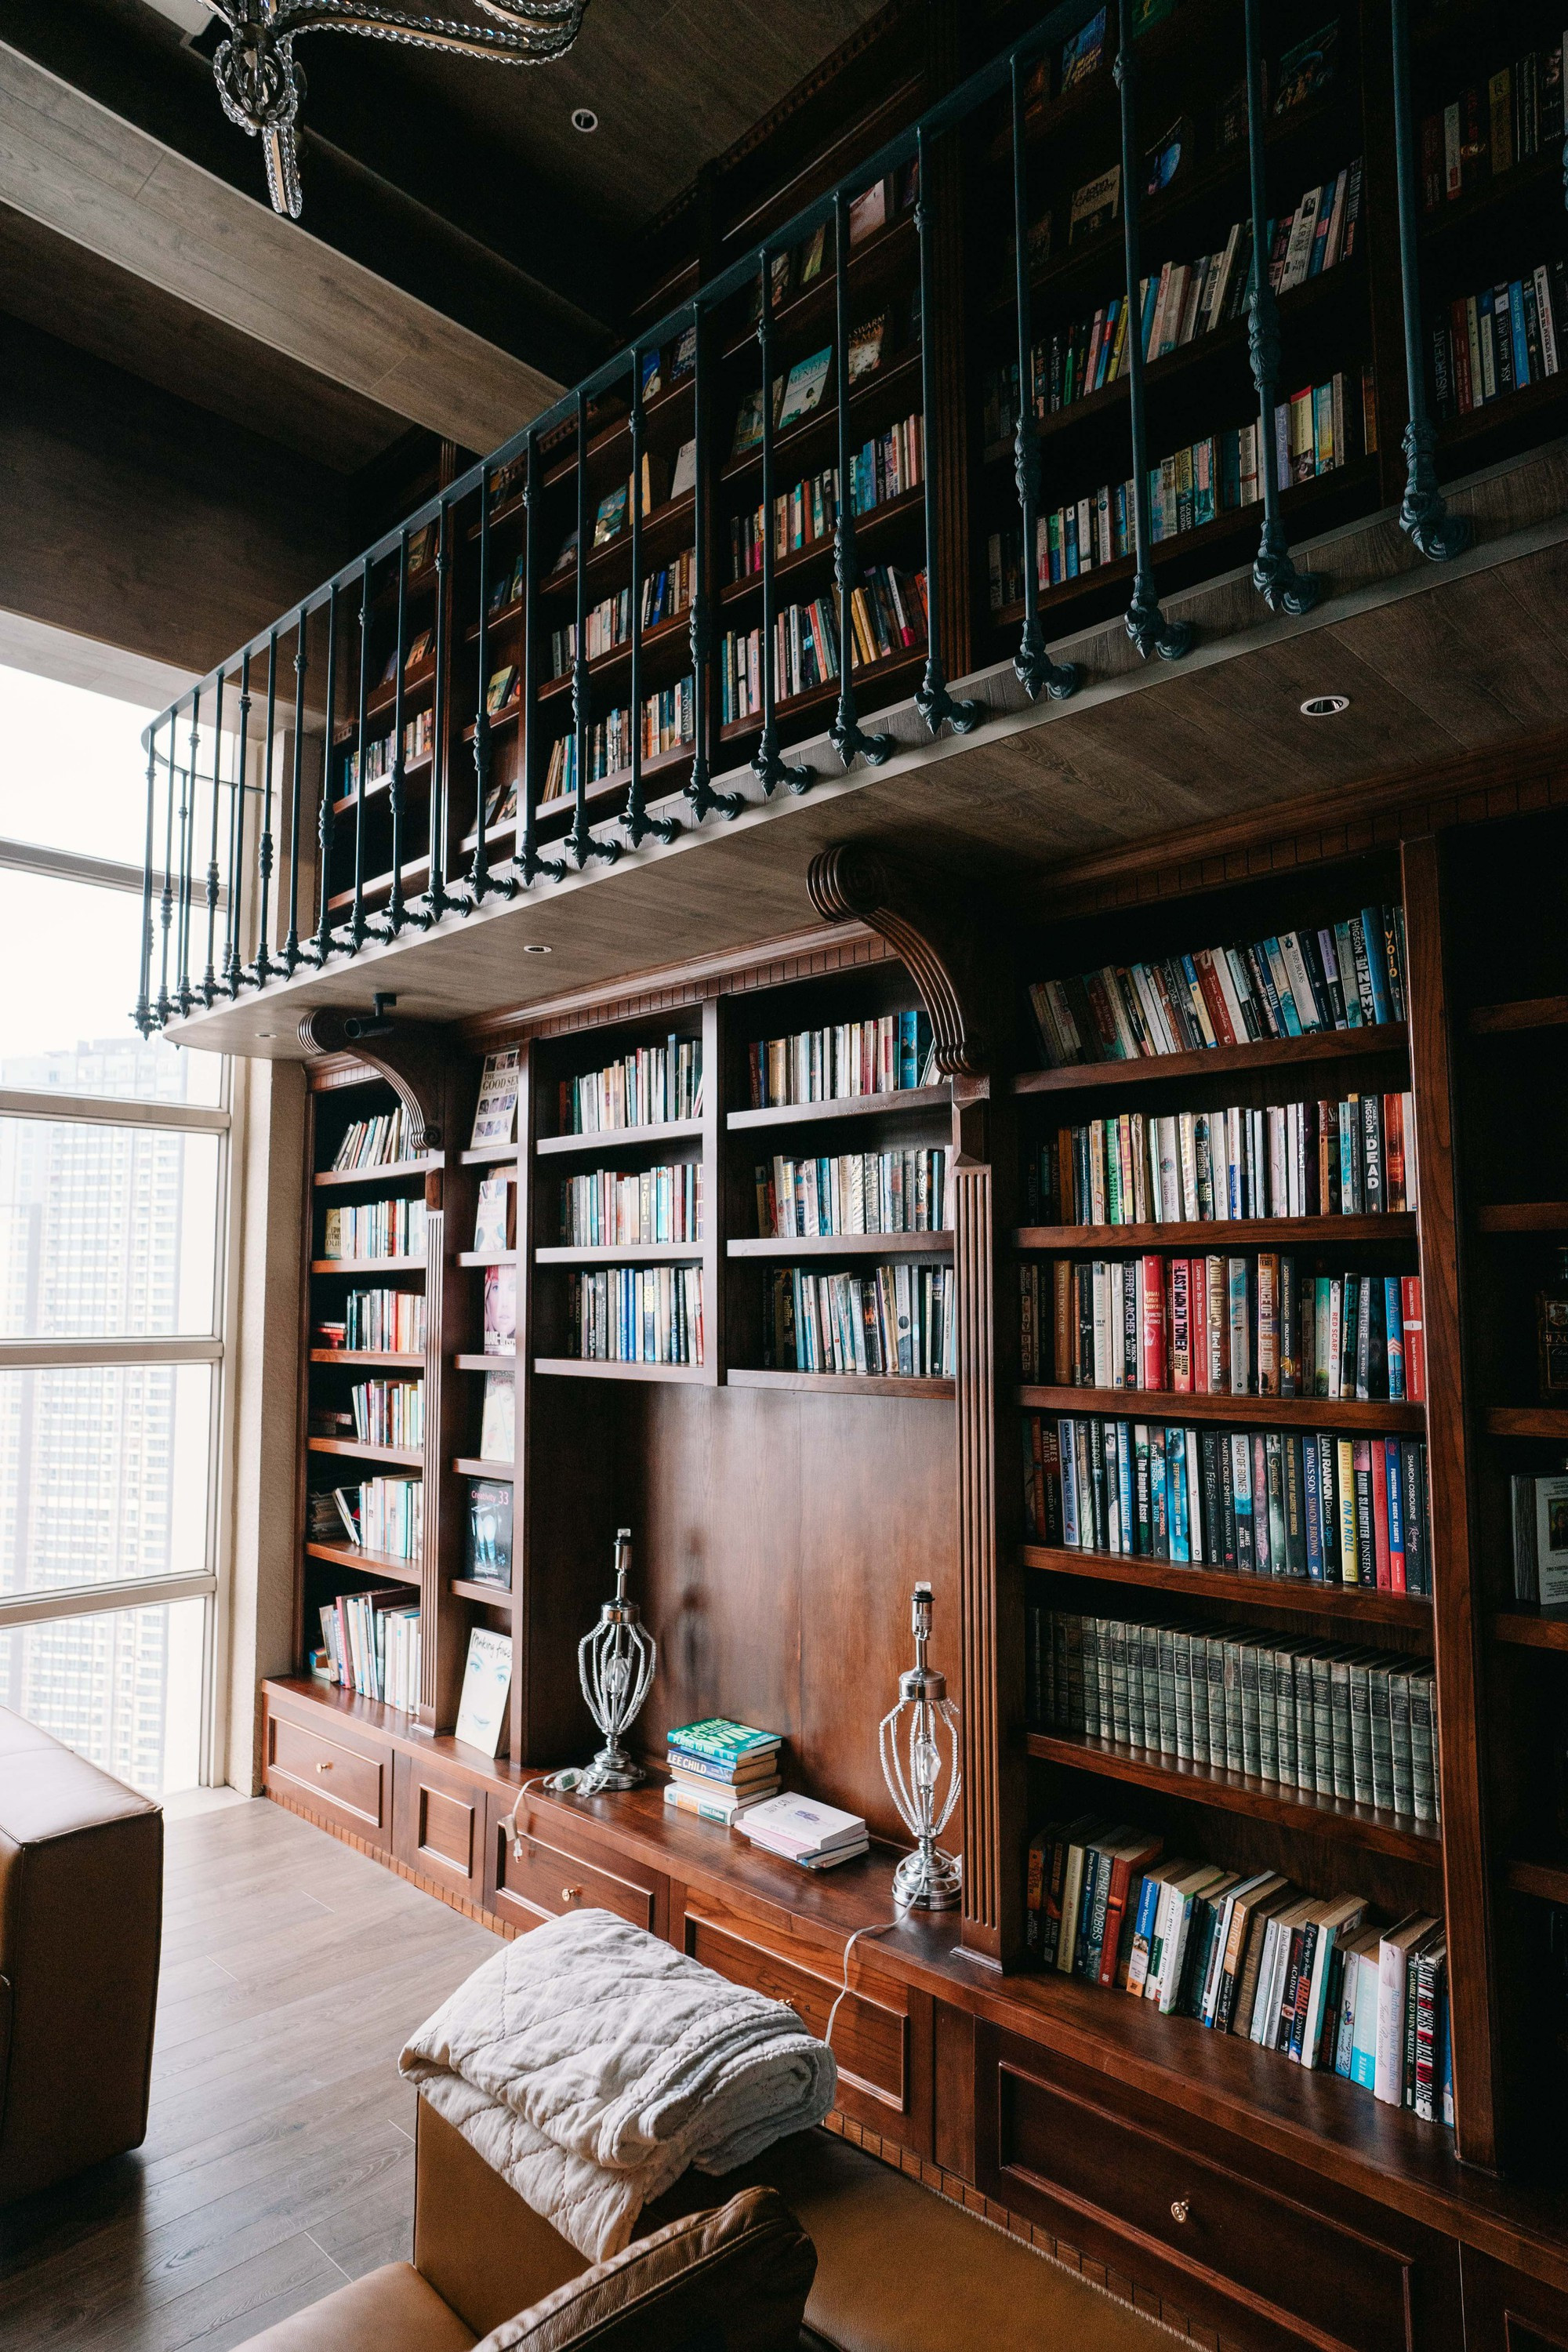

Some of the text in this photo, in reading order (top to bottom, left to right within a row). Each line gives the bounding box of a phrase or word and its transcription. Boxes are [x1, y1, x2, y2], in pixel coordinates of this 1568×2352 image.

[1432, 331, 1448, 402] INSURGENT
[1350, 921, 1363, 954] HIGSON
[1231, 963, 1241, 982] Coroner's
[1291, 950, 1301, 964] TERRY
[1294, 964, 1305, 983] BROOKS
[1208, 975, 1219, 994] Diane
[1215, 996, 1229, 1029] Chamberlain
[1266, 983, 1279, 1009] RODZINA
[1355, 959, 1374, 1020] ENEMY
[483, 1078, 506, 1091] GOOD
[1364, 1099, 1374, 1133] HIGSON
[1196, 1141, 1208, 1178] Patterson
[1367, 1138, 1379, 1189] DEAD
[783, 1295, 792, 1326] Patterson
[1124, 1268, 1135, 1334] JEFFREY ARCHER
[1174, 1269, 1187, 1351] LAST MAN IN TOWER
[1197, 1292, 1203, 1301] No
[1208, 1260, 1227, 1328] Tom Clancy
[1261, 1269, 1273, 1370] PRINCE OF THE BLOOD
[1211, 1331, 1221, 1380] Red Rabbit
[1042, 1430, 1051, 1463] ROLLINS
[1049, 1432, 1058, 1462] JAMES
[1064, 1423, 1073, 1464] CHAMELEON
[1236, 1441, 1247, 1494] MAP OF BONES
[1268, 1457, 1279, 1496] Graceling
[1306, 1447, 1316, 1494] RIVAL'S SON
[1321, 1438, 1333, 1500] IAN RANKIN
[471, 1490, 509, 1505] Creativity 33
[1137, 1459, 1149, 1523] The Bangkok Asset
[1343, 1501, 1352, 1515] ON
[1357, 1472, 1370, 1539] KARIN SLAUGHTER
[1308, 1497, 1319, 1555] SIMON BROWN
[1324, 1526, 1334, 1547] Open
[1345, 1528, 1354, 1553] ROLL
[1361, 1541, 1370, 1573] UNSEEN
[673, 1736, 714, 1755] PLAYING TO WIN
[679, 1719, 728, 1739] PLAYING
[688, 1733, 706, 1742] TO
[702, 1724, 761, 1748] WIN
[668, 1752, 706, 1774] LEE CHILD
[1092, 1857, 1110, 1941] MICHAEL DOBBS
[1140, 1882, 1153, 1933] Volunteer Vacations
[1229, 1911, 1244, 1951] Traitor
[1288, 1964, 1298, 2002] ACADEMY
[1417, 1962, 1435, 2030] KATHY REICHS
[1409, 2002, 1415, 2012] TO
[1388, 1989, 1399, 2090] Barbara Taylor Bradford
[1358, 2057, 1367, 2082] WHITE
